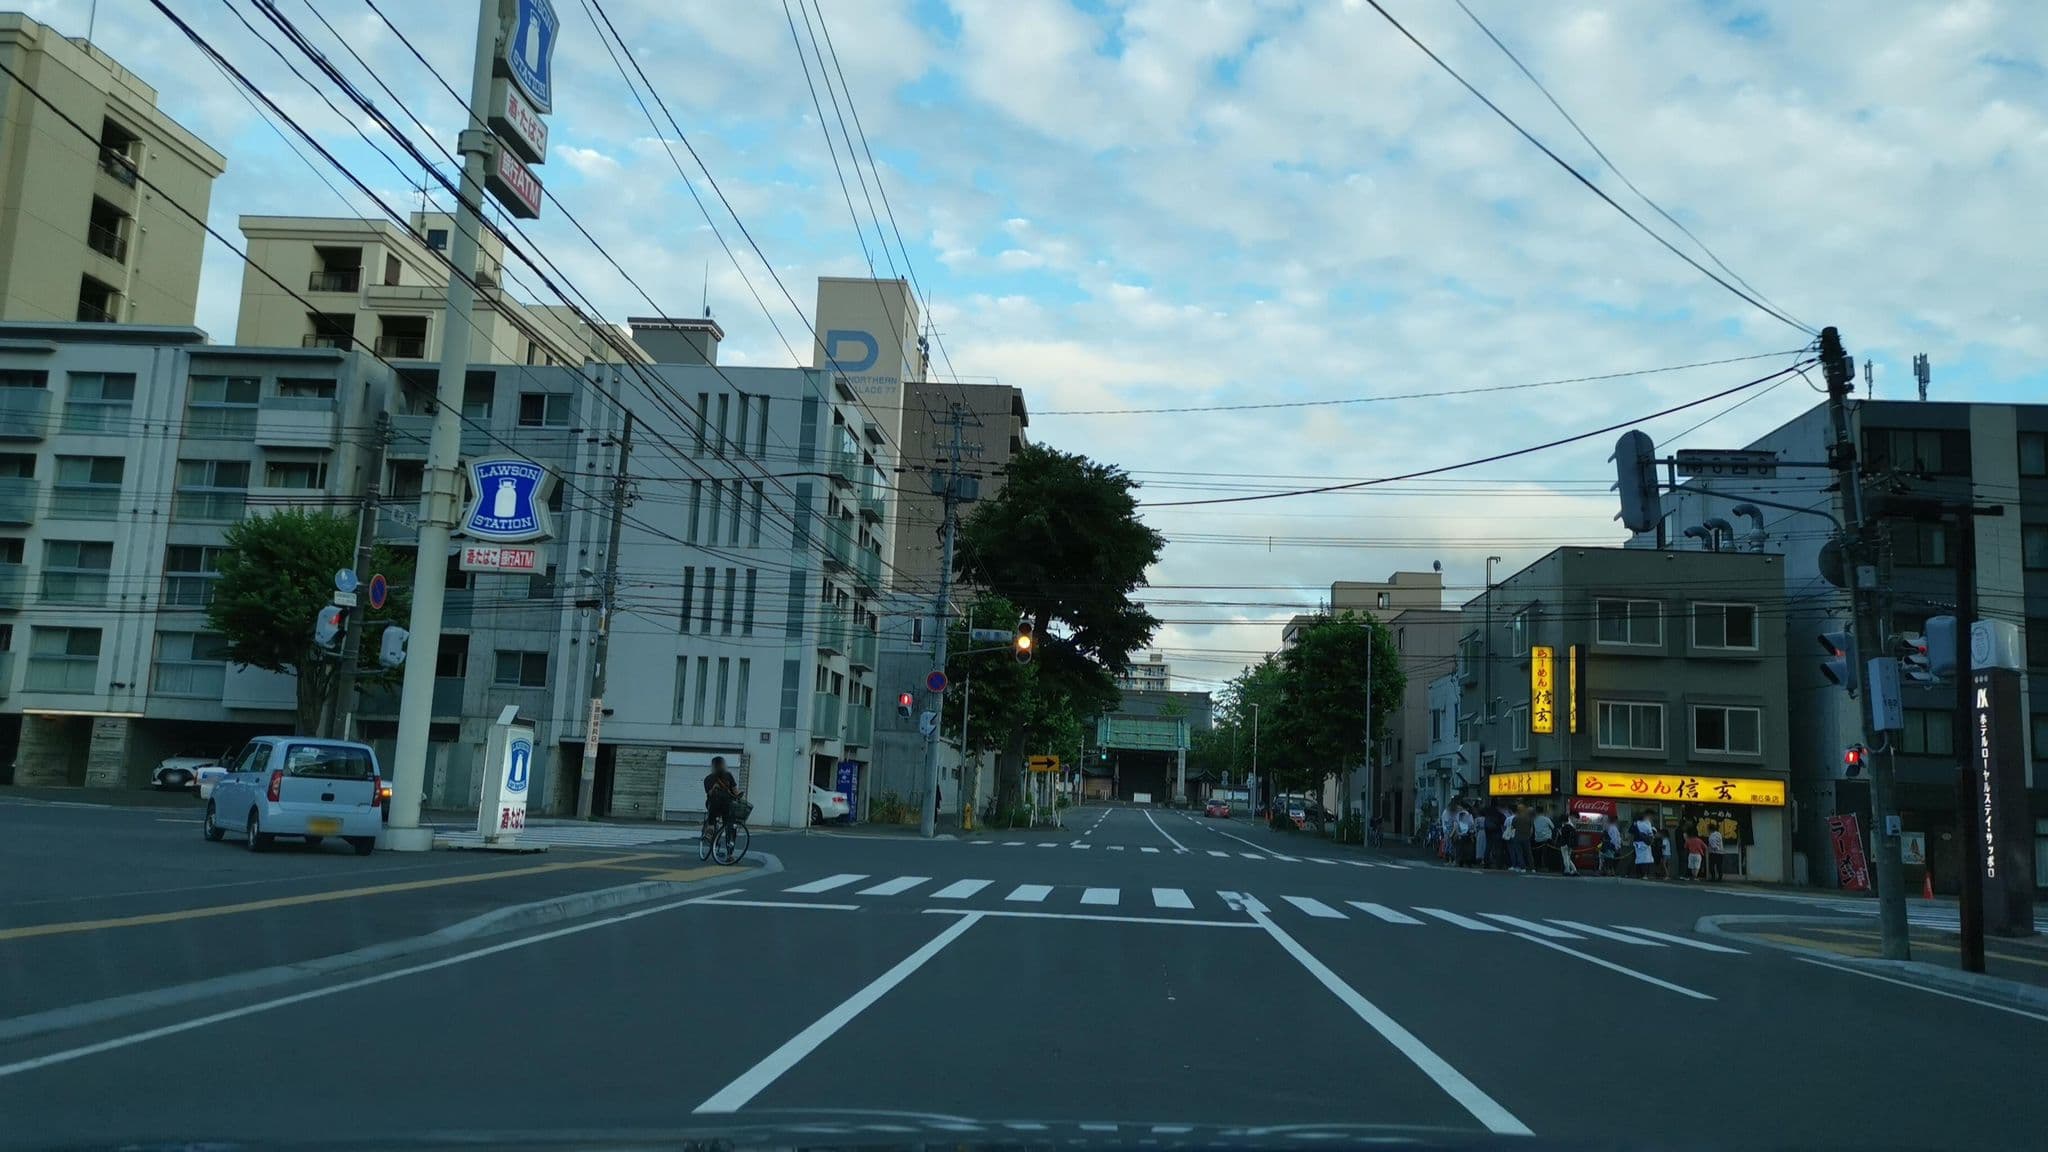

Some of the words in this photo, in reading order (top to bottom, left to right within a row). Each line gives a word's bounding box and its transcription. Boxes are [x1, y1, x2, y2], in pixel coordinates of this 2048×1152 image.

[512, 49, 546, 98] STATION
[502, 150, 539, 206] 銀行ATM
[480, 465, 538, 480] LAWSON
[474, 515, 532, 530] STATION
